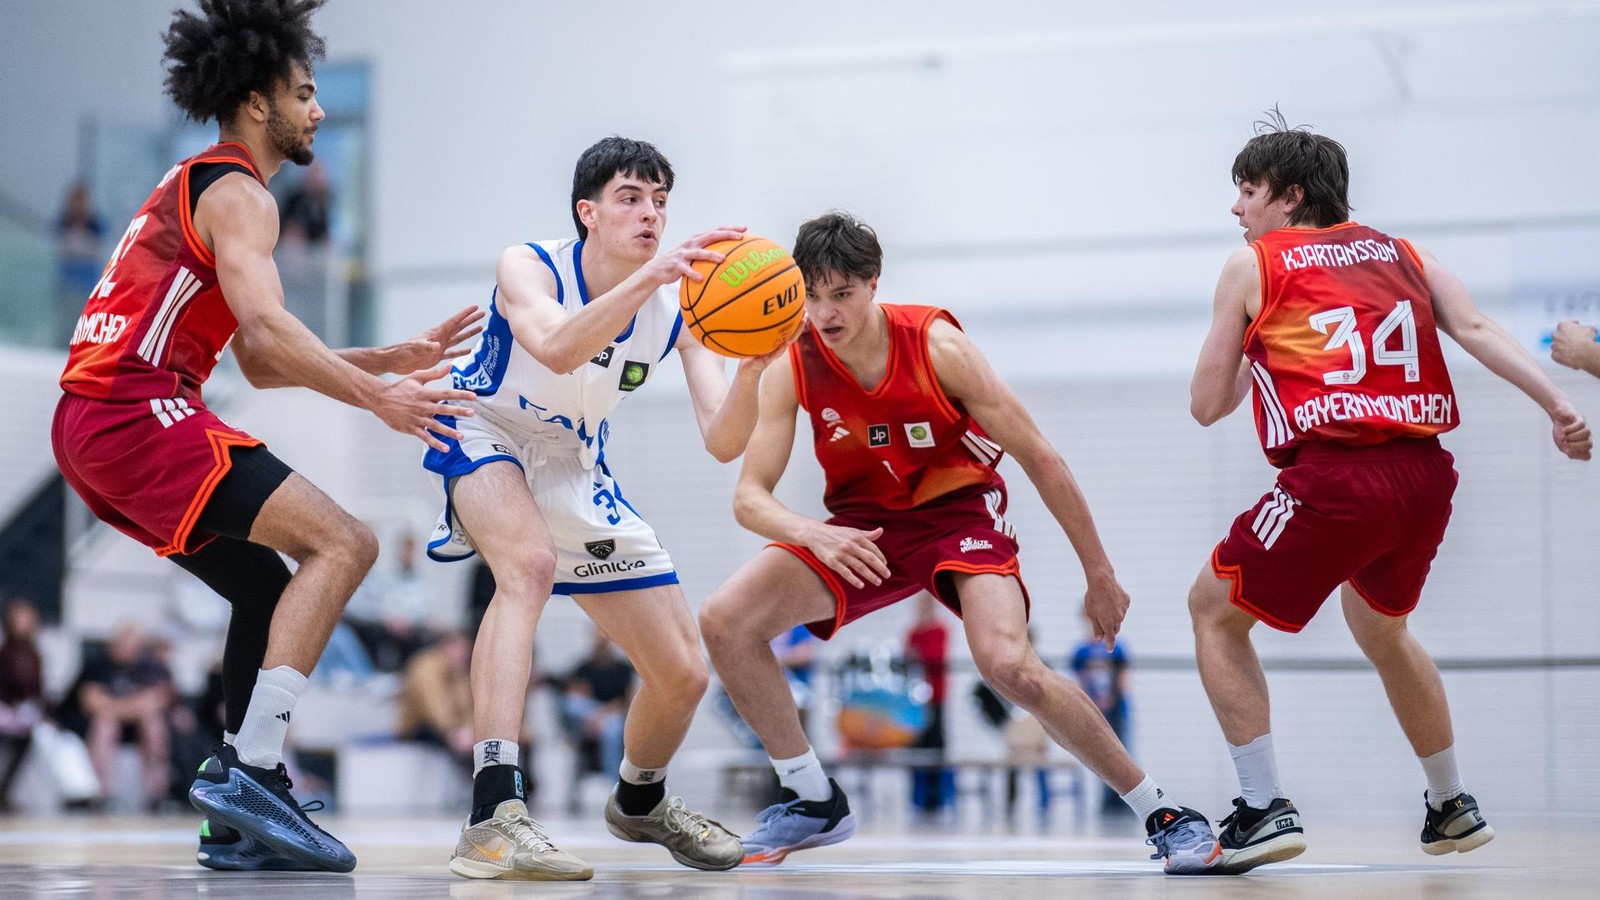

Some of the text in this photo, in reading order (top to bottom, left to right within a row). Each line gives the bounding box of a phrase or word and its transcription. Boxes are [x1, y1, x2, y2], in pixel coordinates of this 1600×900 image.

[1281, 239, 1399, 271] KJARTANSSON
[763, 283, 798, 316] EVO
[1308, 300, 1420, 385] 34
[593, 489, 621, 525] 3
[573, 560, 646, 578] Glinicke
[1454, 799, 1465, 809] 12
